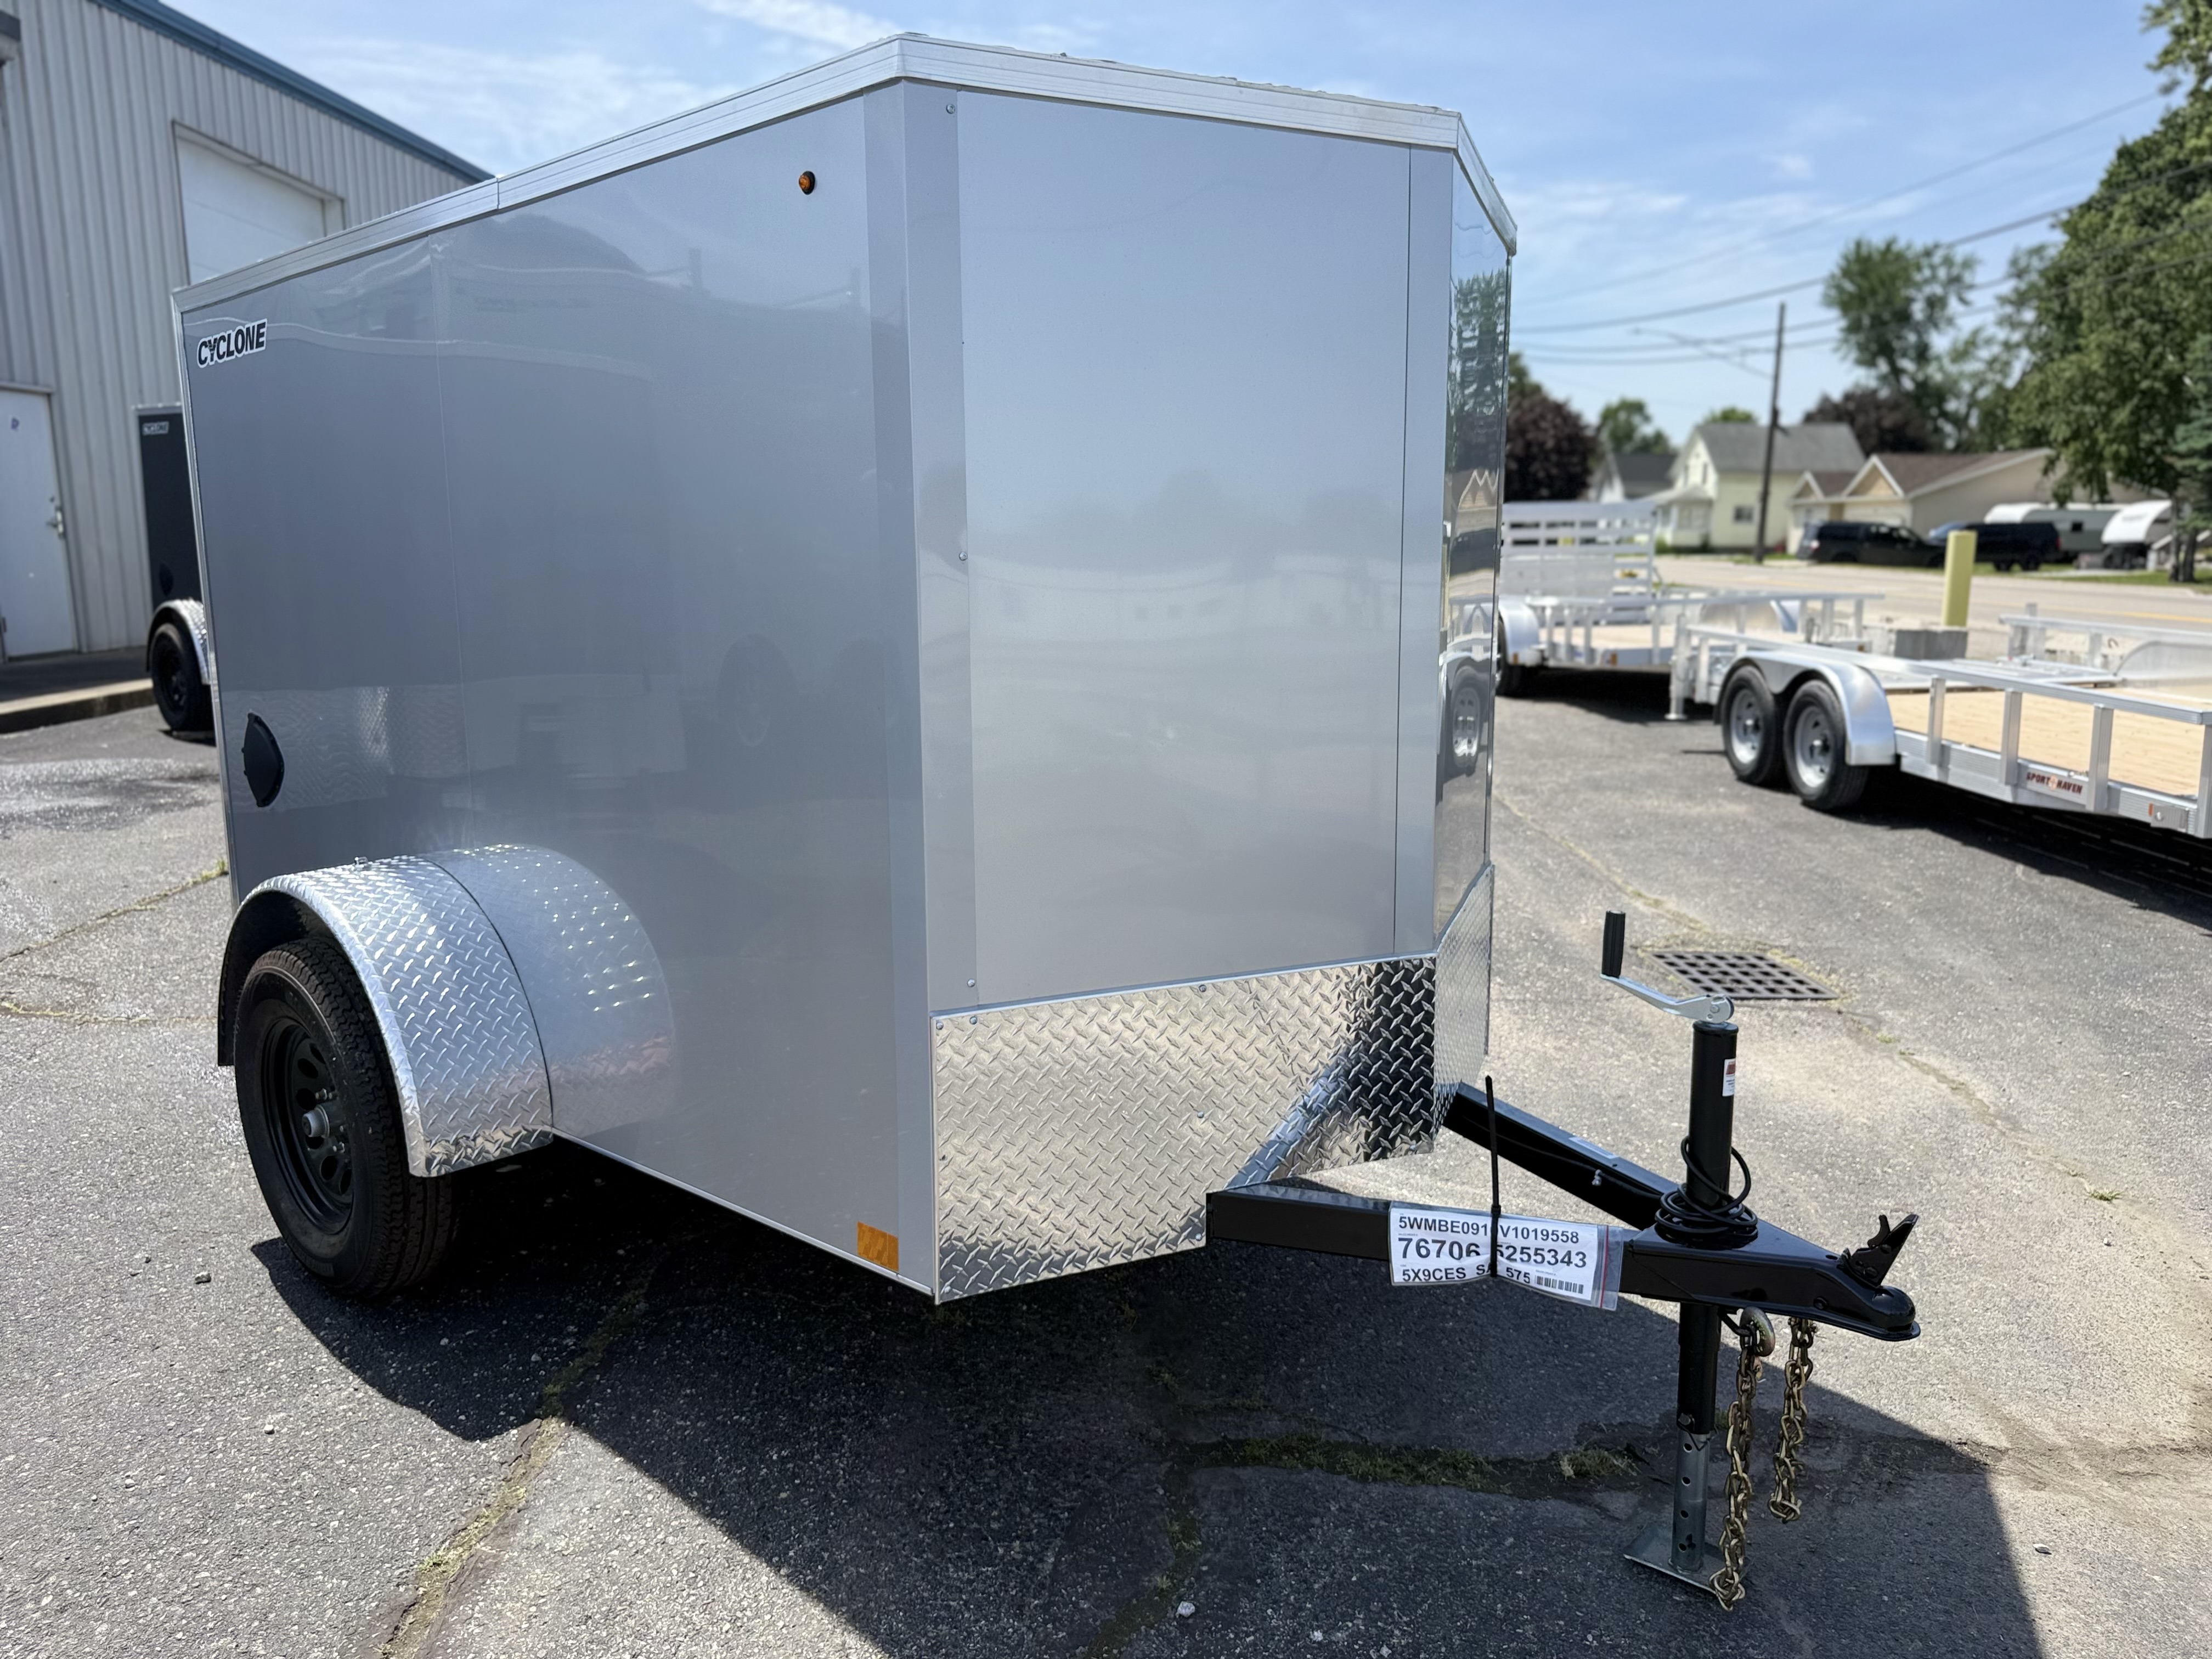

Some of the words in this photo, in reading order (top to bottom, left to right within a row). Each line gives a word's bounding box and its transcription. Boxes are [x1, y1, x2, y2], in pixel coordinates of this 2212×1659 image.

[198, 321, 266, 365] CYCLONE
[2027, 772, 2051, 786] SPORT
[2056, 779, 2083, 794] HAVEN
[1399, 1216, 1579, 1244] 5WMBE091V1019558
[1398, 1237, 1481, 1261] 76706
[1402, 1267, 1466, 1282] 5X9CES
